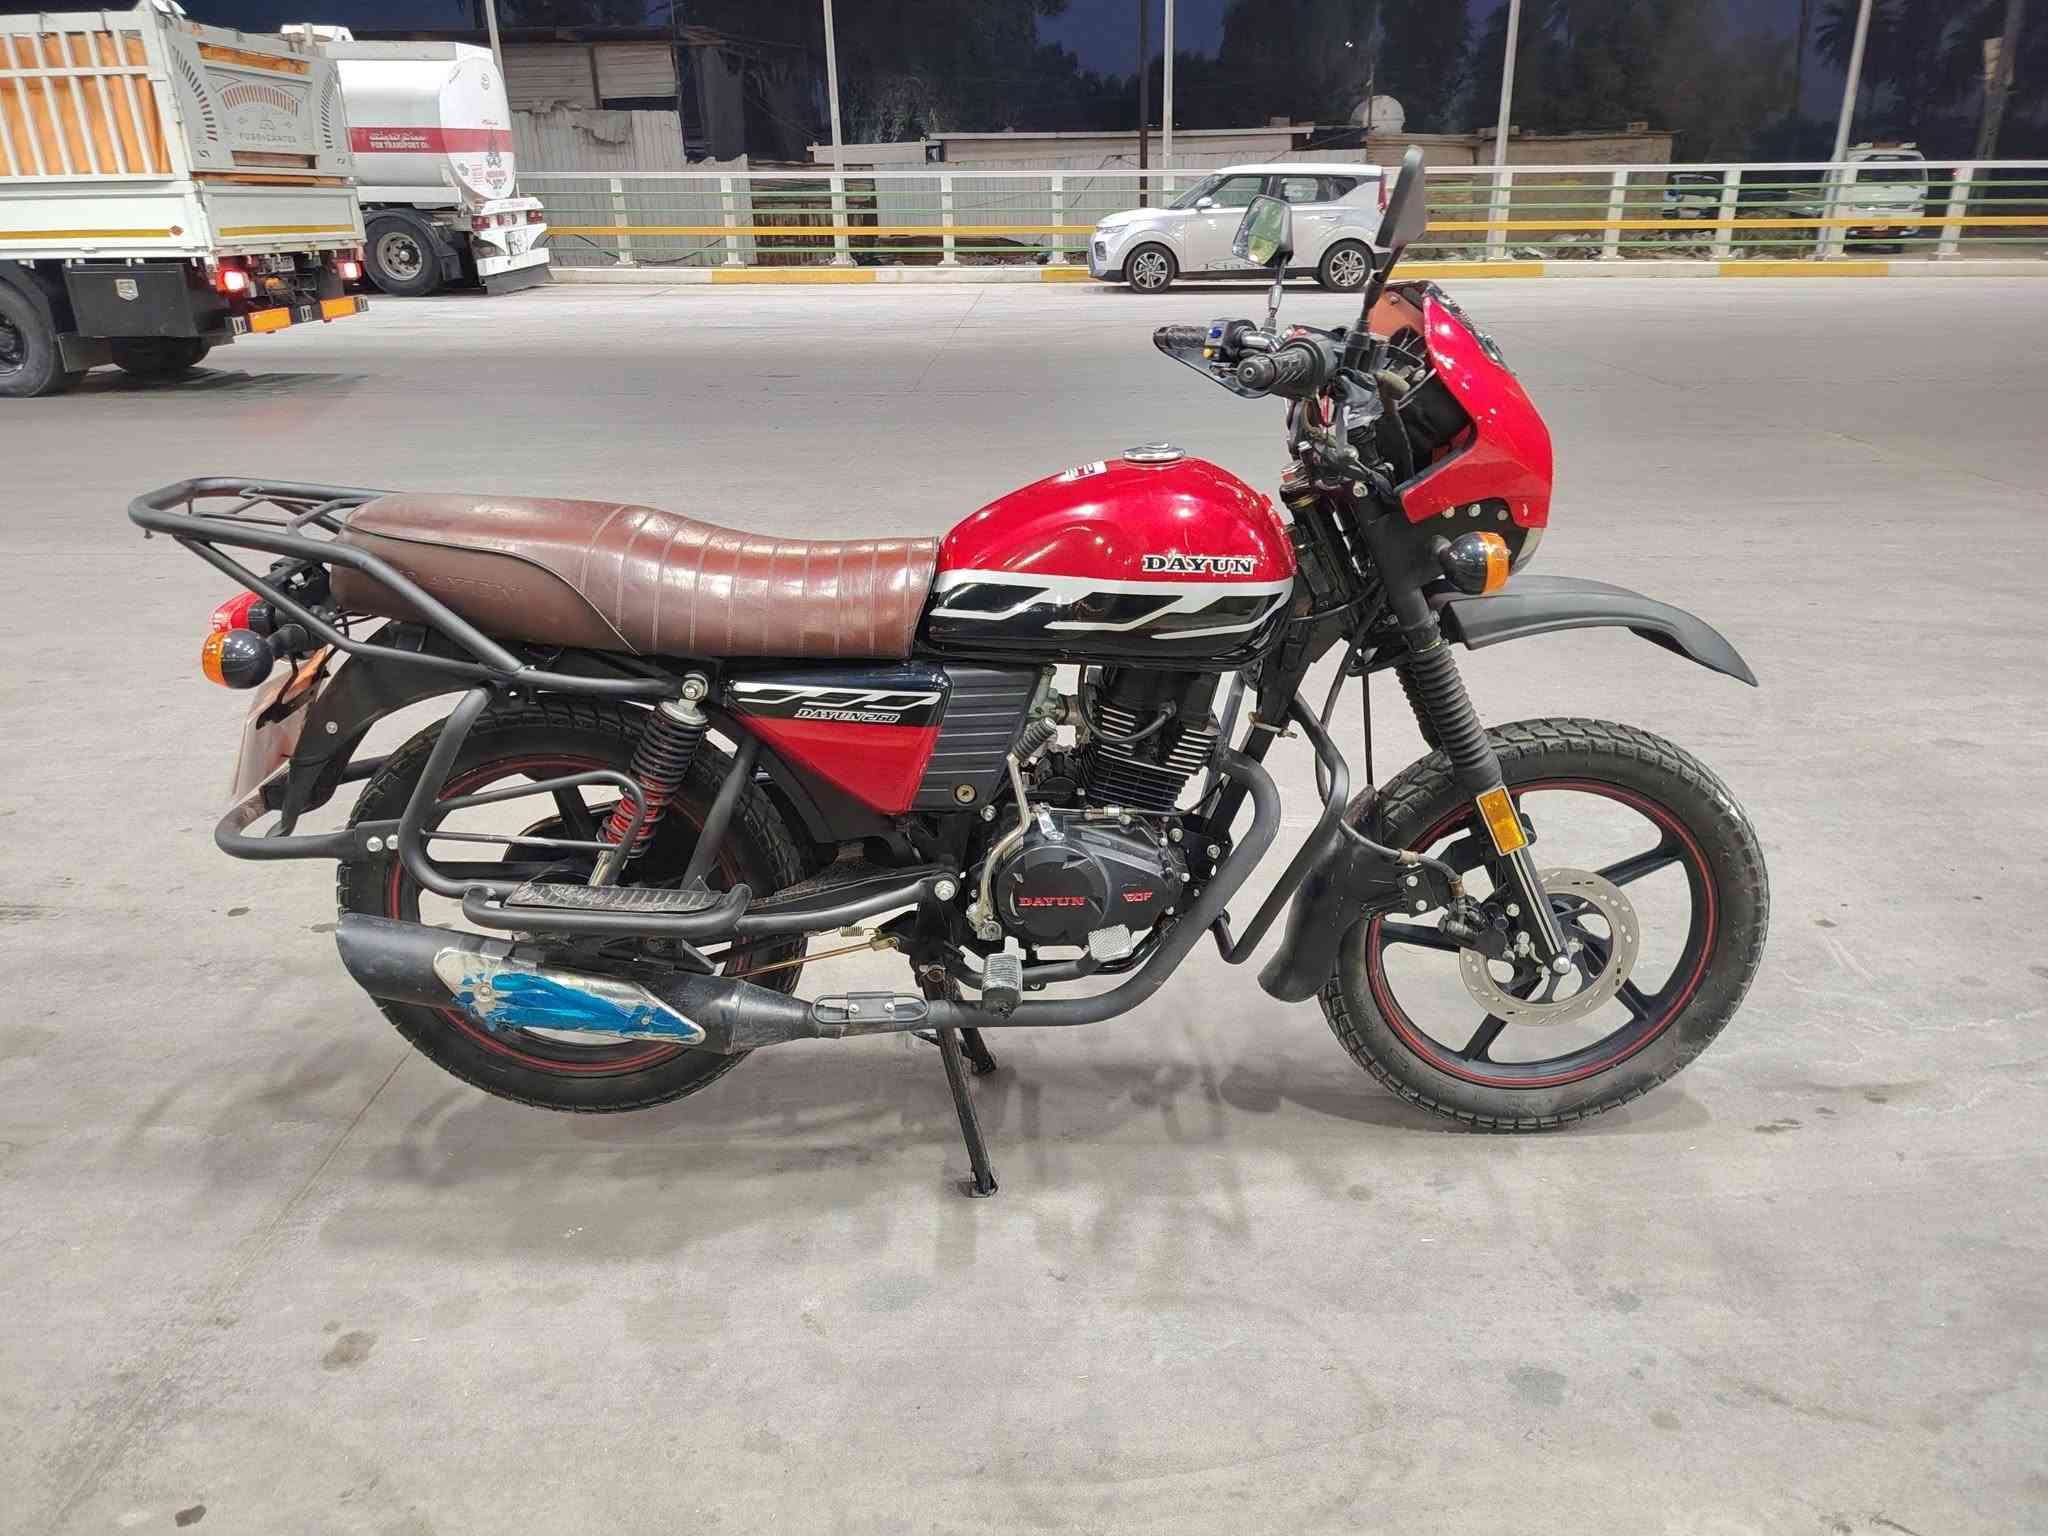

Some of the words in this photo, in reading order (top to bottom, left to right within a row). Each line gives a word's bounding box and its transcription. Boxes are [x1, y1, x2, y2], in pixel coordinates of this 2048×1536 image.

[1142, 555, 1255, 576] DAYUN
[795, 709, 863, 721] DAYUN
[1018, 896, 1086, 906] DAYUN
